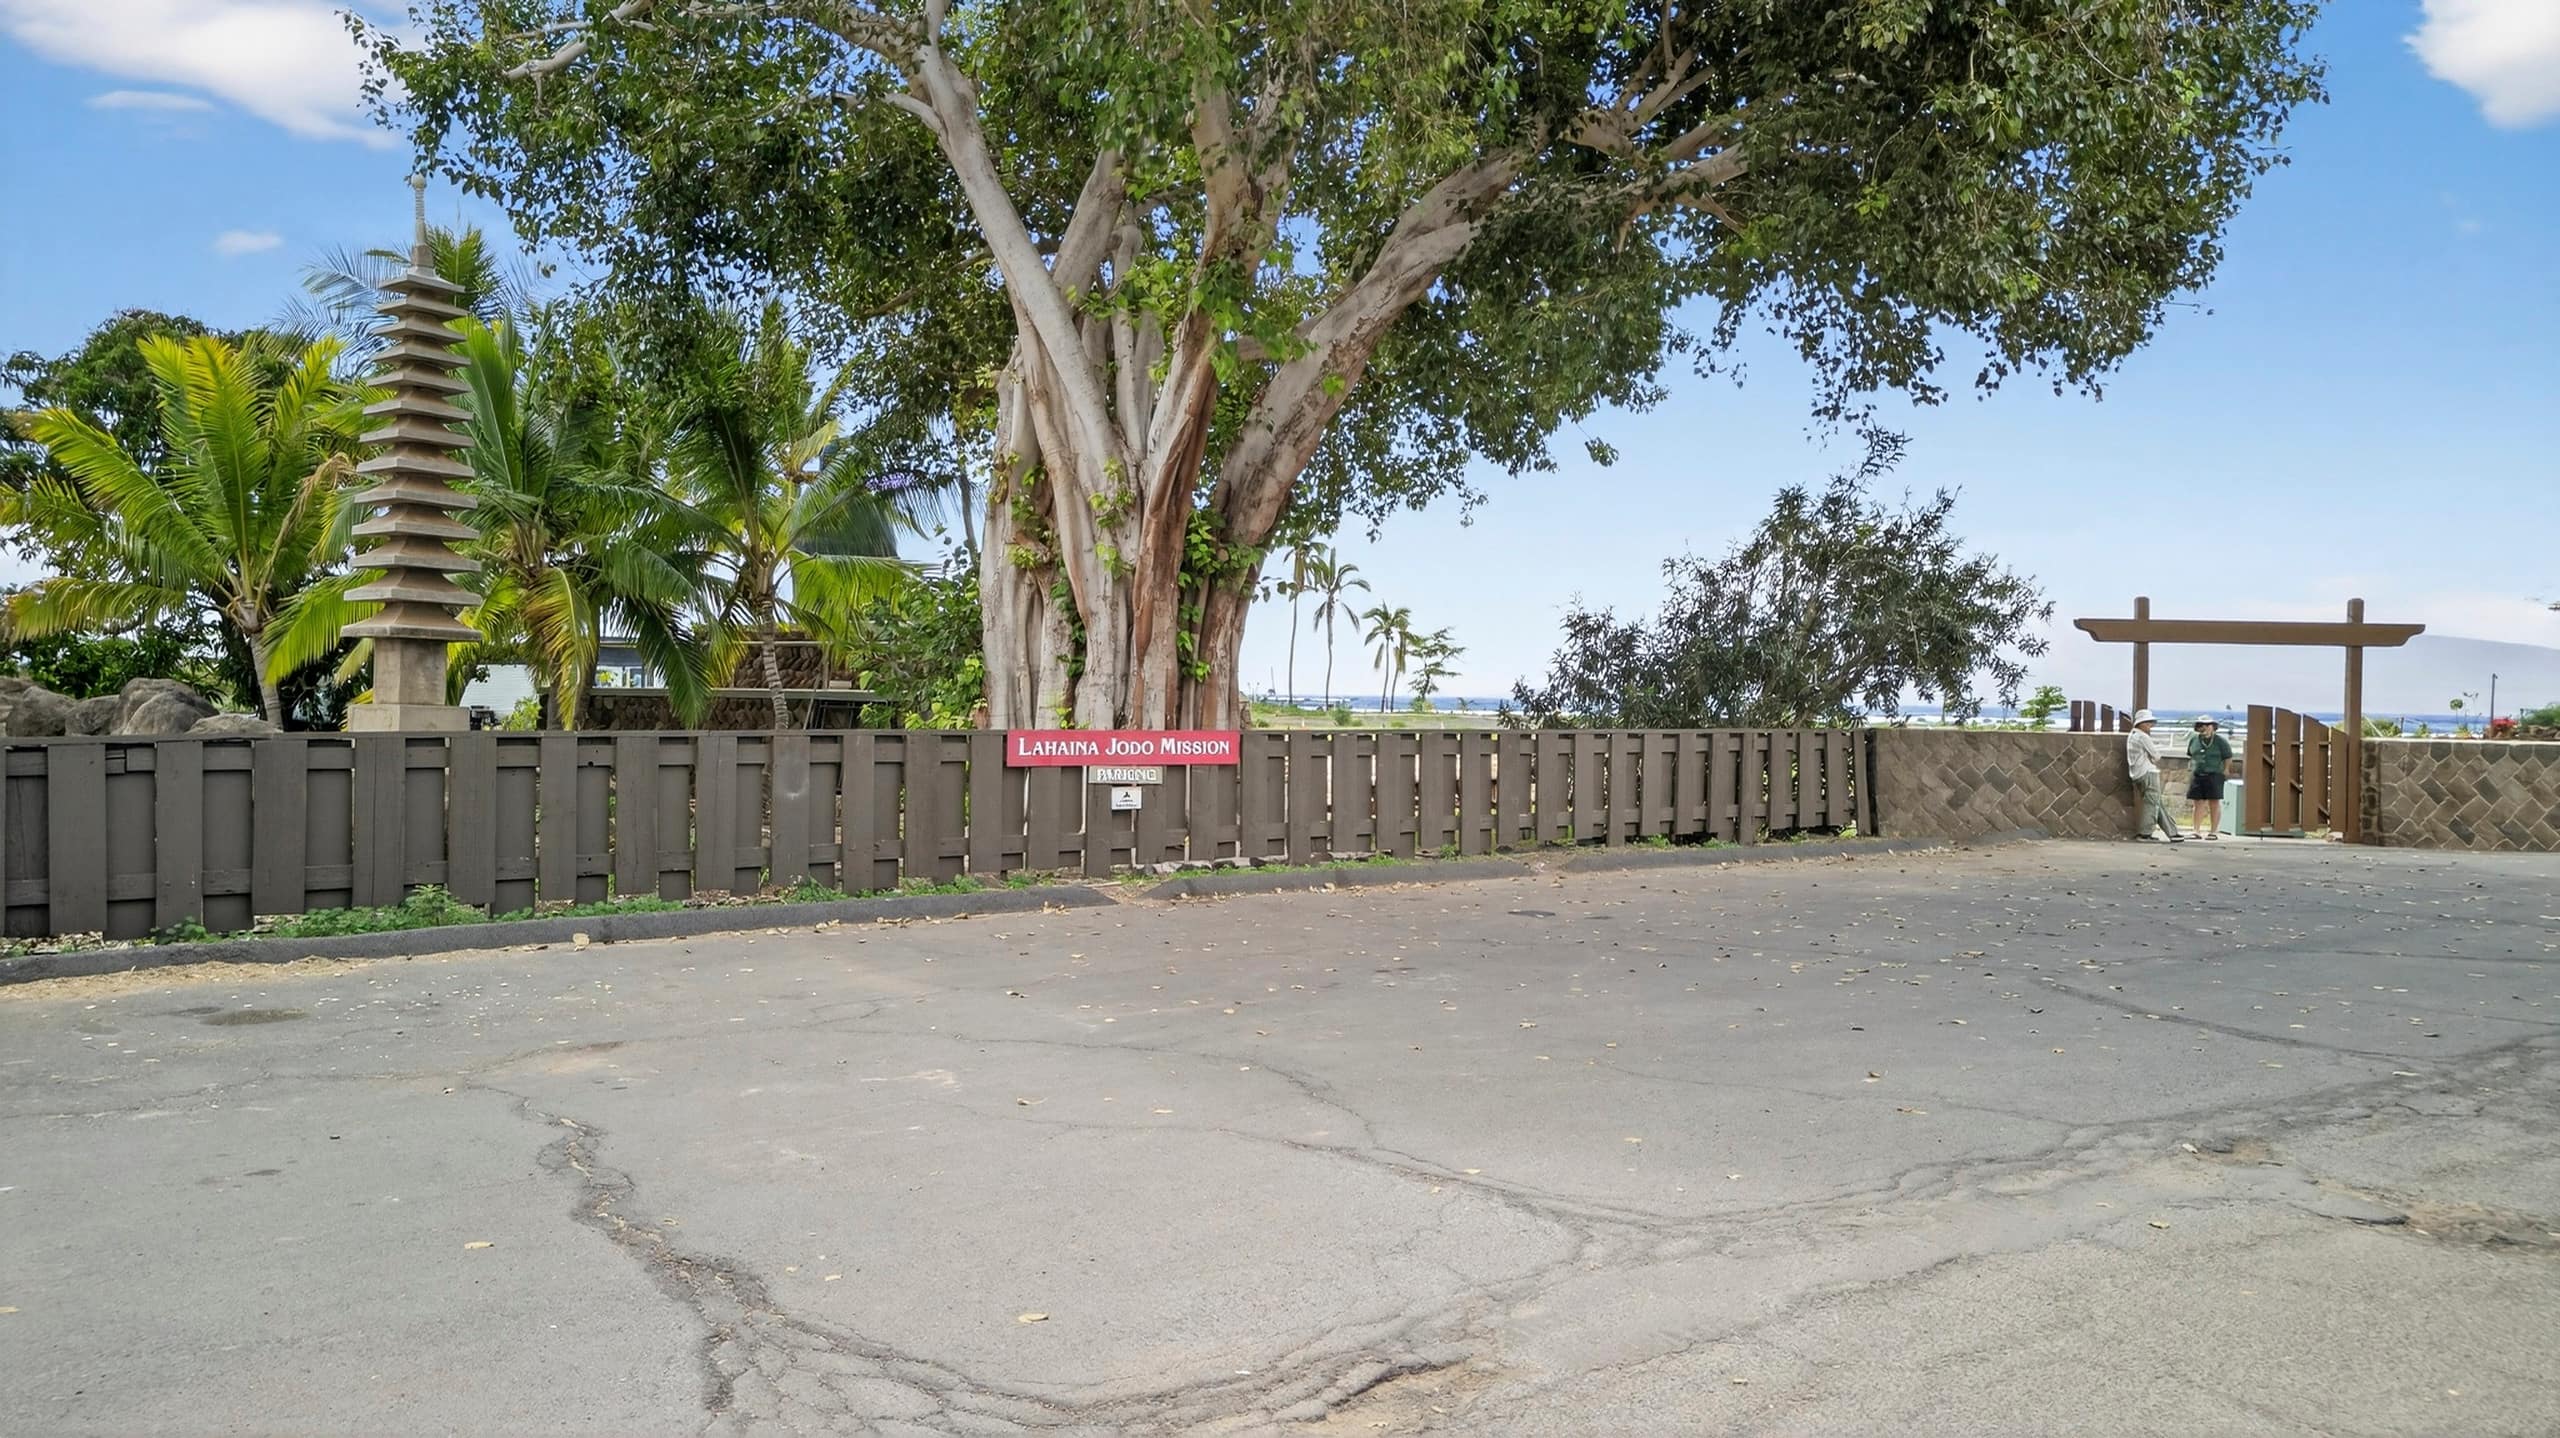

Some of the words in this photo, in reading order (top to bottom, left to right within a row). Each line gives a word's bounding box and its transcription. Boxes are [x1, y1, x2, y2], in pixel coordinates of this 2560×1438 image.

[1018, 737, 1099, 756] LAHAINA
[1105, 737, 1154, 756] JODO
[1160, 737, 1230, 755] MISSION
